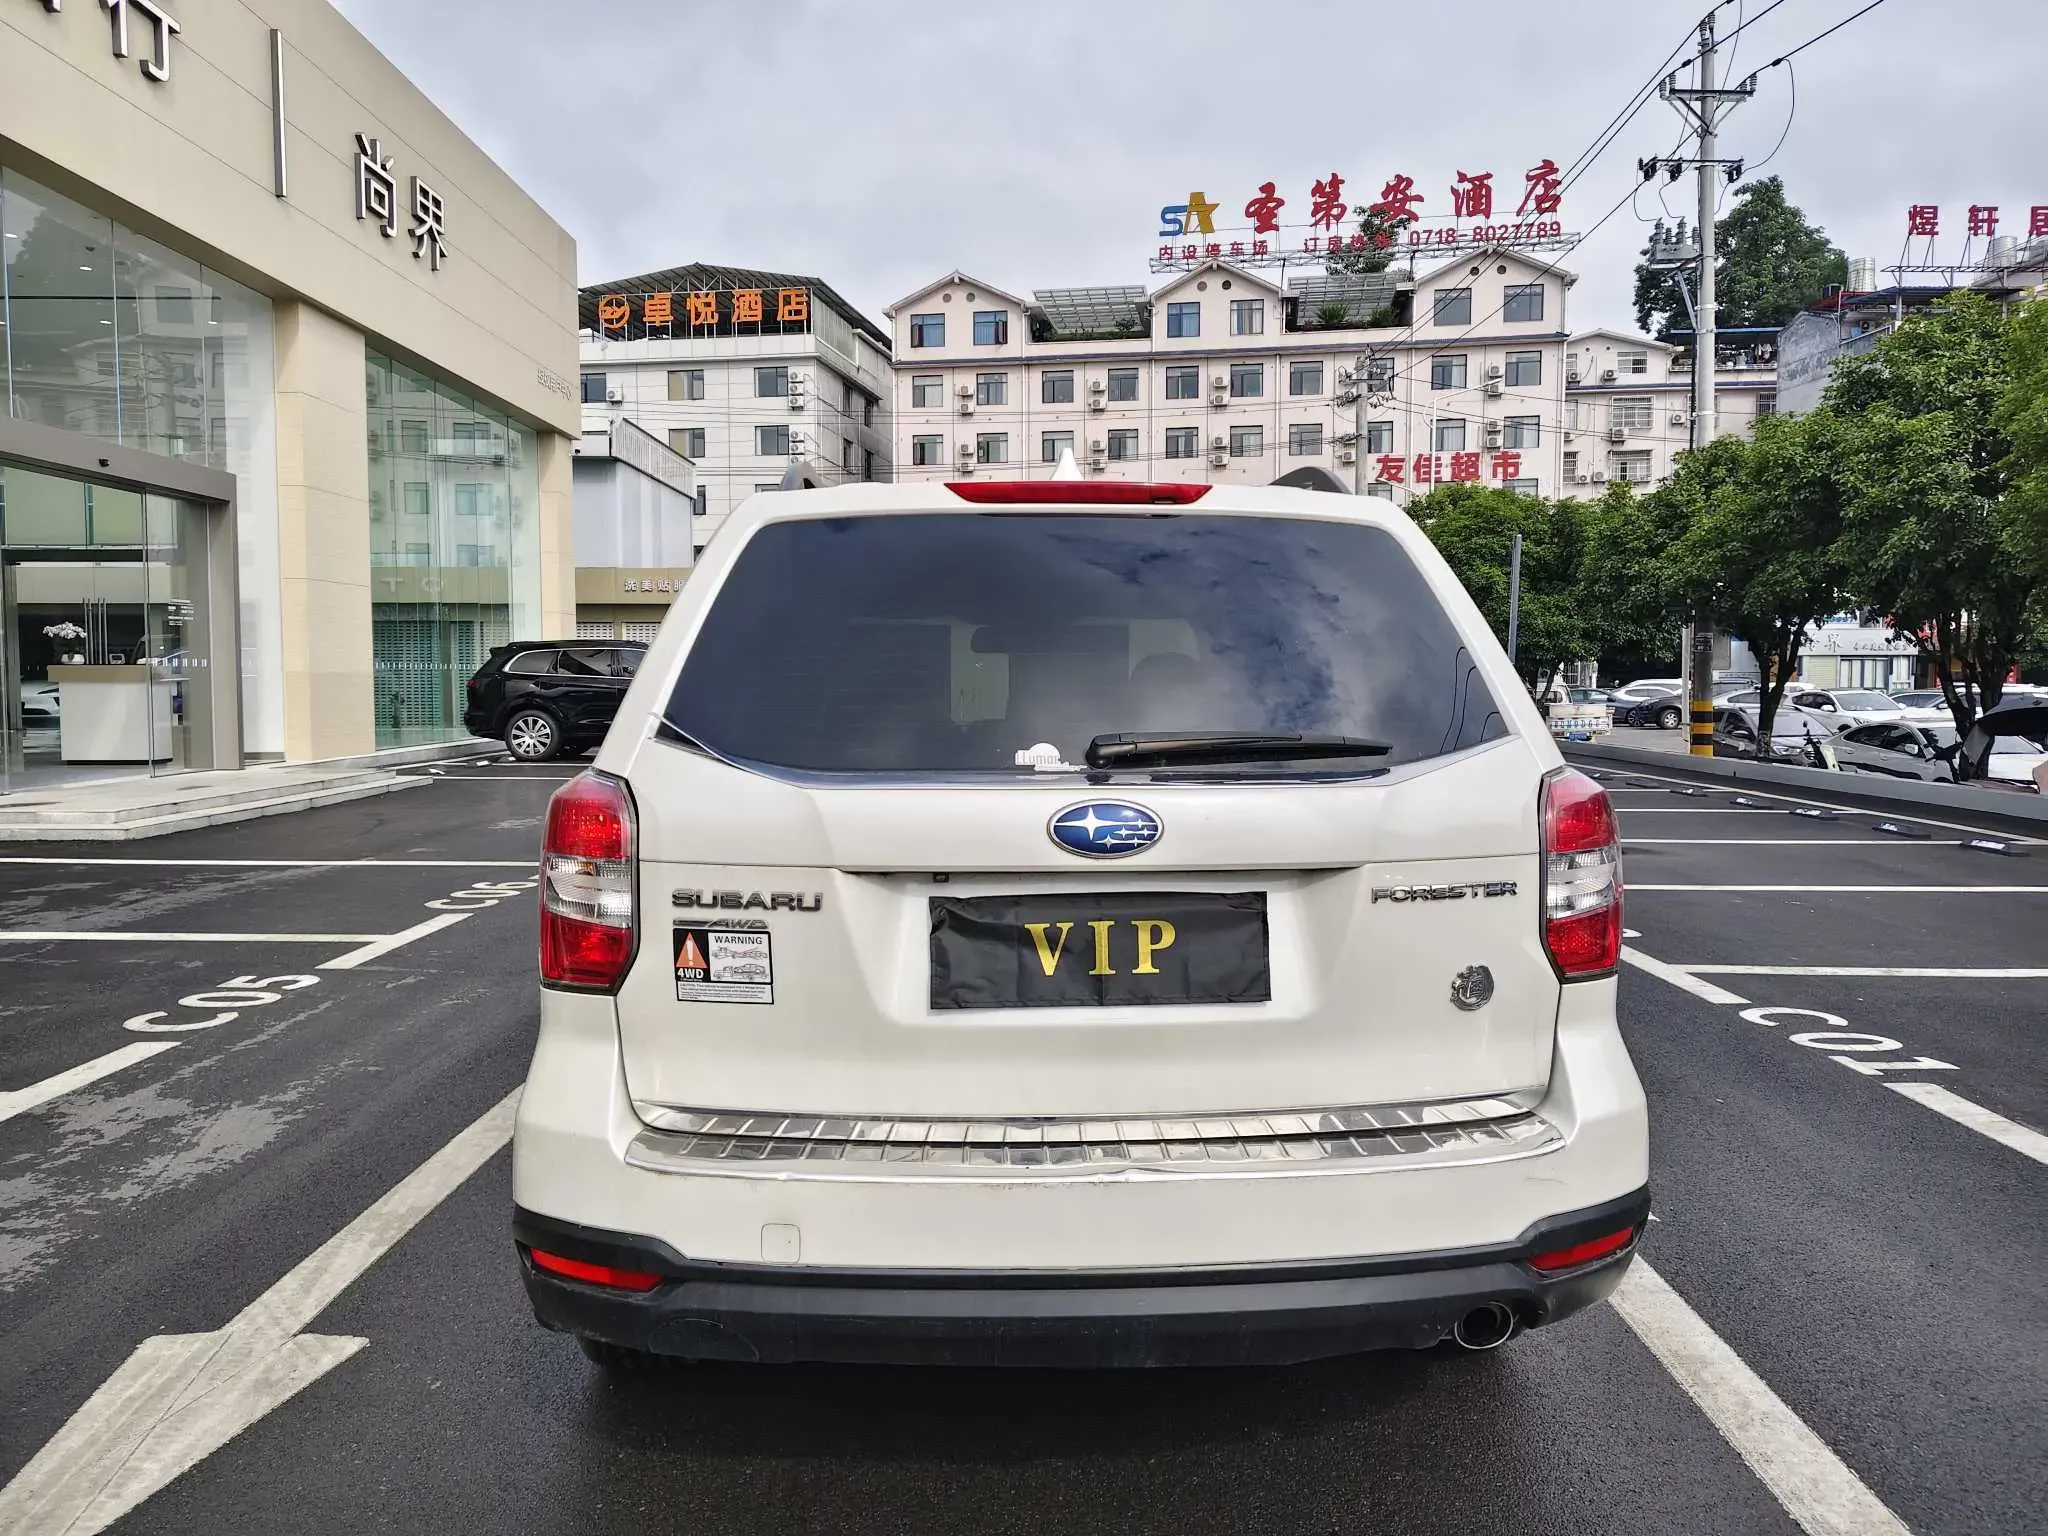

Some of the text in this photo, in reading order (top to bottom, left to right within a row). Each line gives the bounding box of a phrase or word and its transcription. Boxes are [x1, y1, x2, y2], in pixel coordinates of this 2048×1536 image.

[353, 131, 448, 272] 尚界
[1244, 158, 1563, 235] 圣第安酒店
[1409, 220, 1562, 247] 0718-8027789
[1159, 240, 1268, 261] 内设停车场
[642, 287, 809, 327] 卓悦酒店
[1375, 450, 1523, 484] 友佳超市
[423, 881, 539, 910] C06
[672, 888, 824, 912] SUBARU
[1371, 880, 1518, 904] FORESTER
[714, 935, 763, 945] WARNING
[1024, 919, 1177, 976] VIP
[677, 967, 704, 979] 4WD
[122, 974, 321, 1034] C05
[1738, 1006, 1961, 1076] C01
